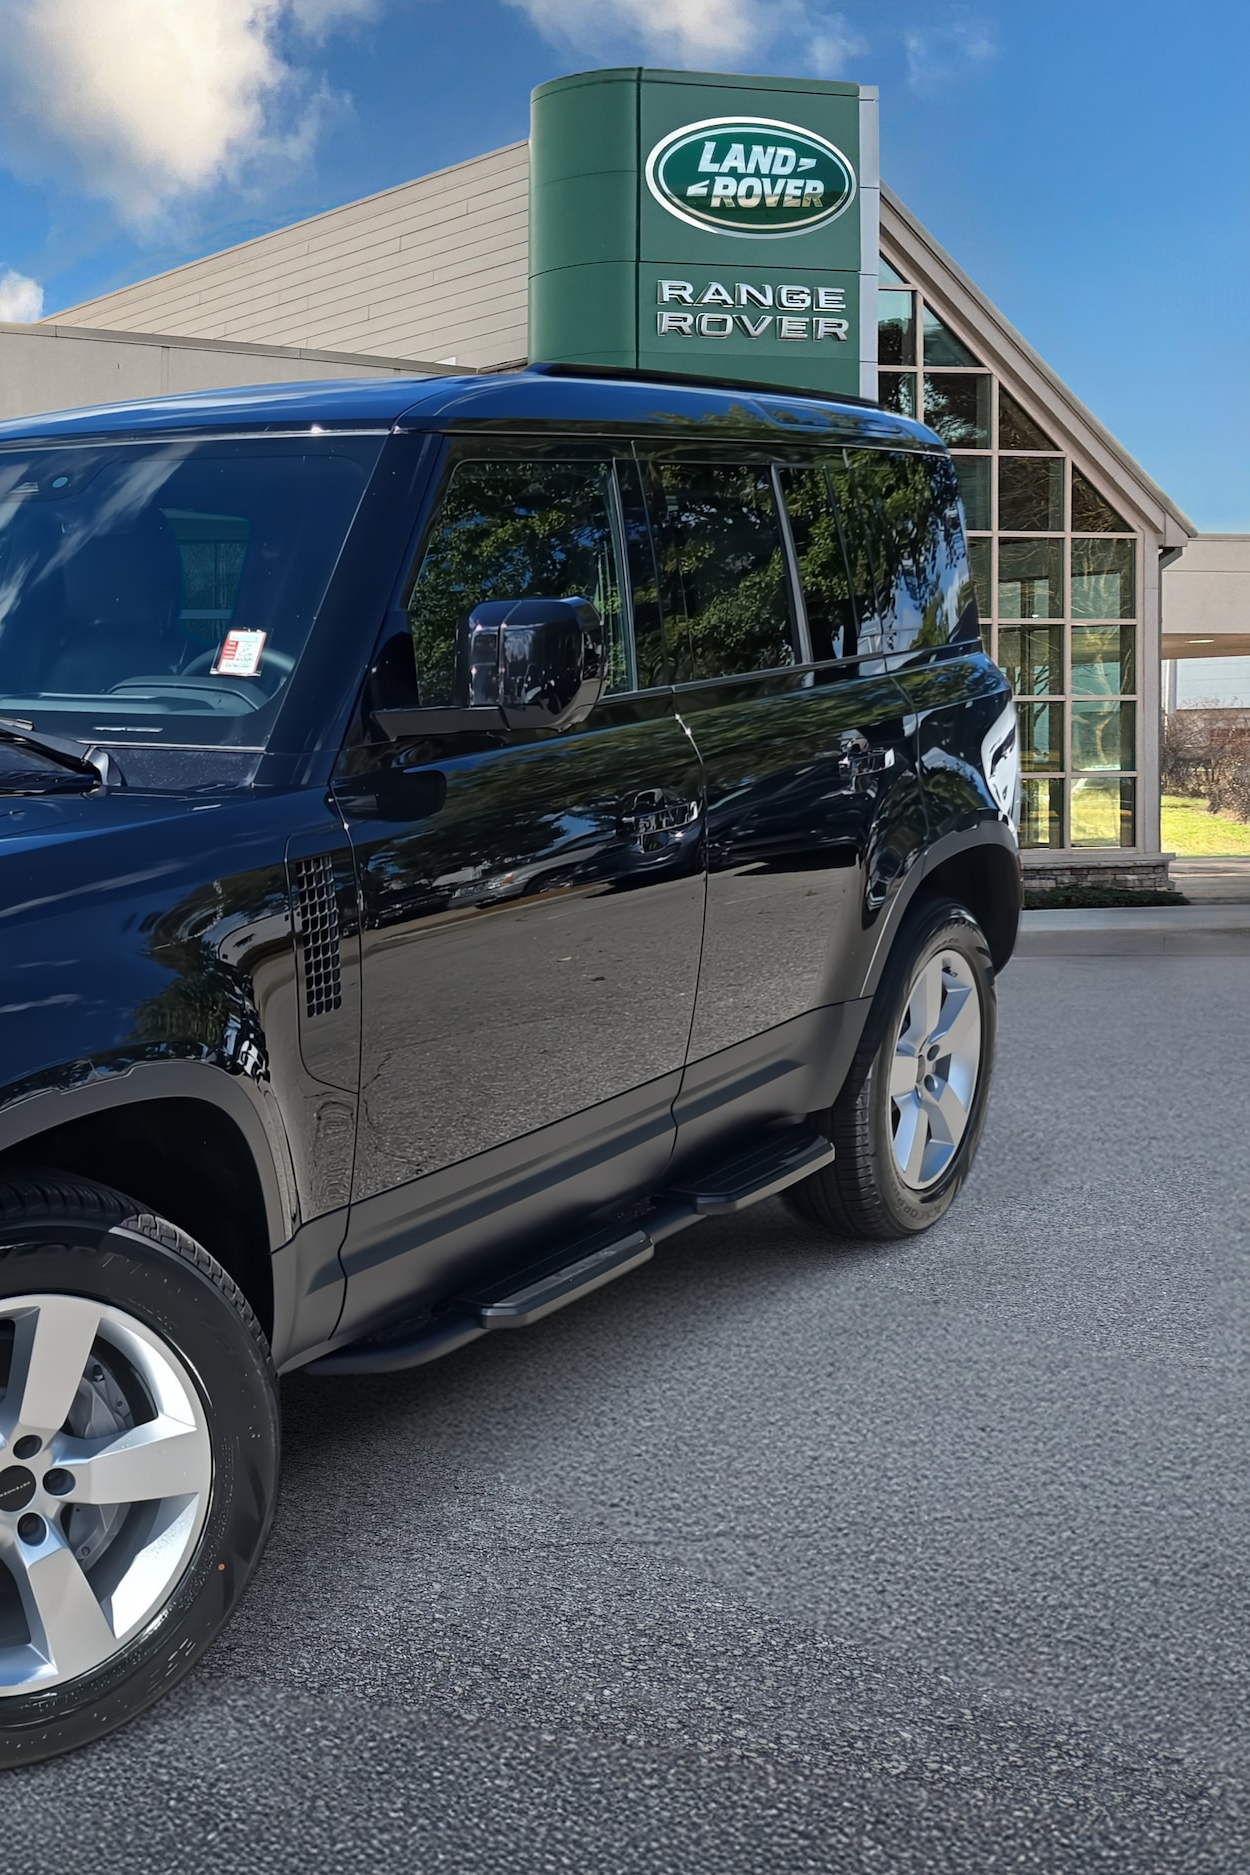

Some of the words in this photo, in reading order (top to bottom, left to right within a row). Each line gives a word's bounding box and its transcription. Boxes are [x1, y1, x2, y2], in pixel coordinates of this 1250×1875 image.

[697, 141, 797, 175] LAND
[710, 176, 825, 208] ROVER
[657, 279, 847, 311] RANGE
[657, 311, 850, 342] ROVER
